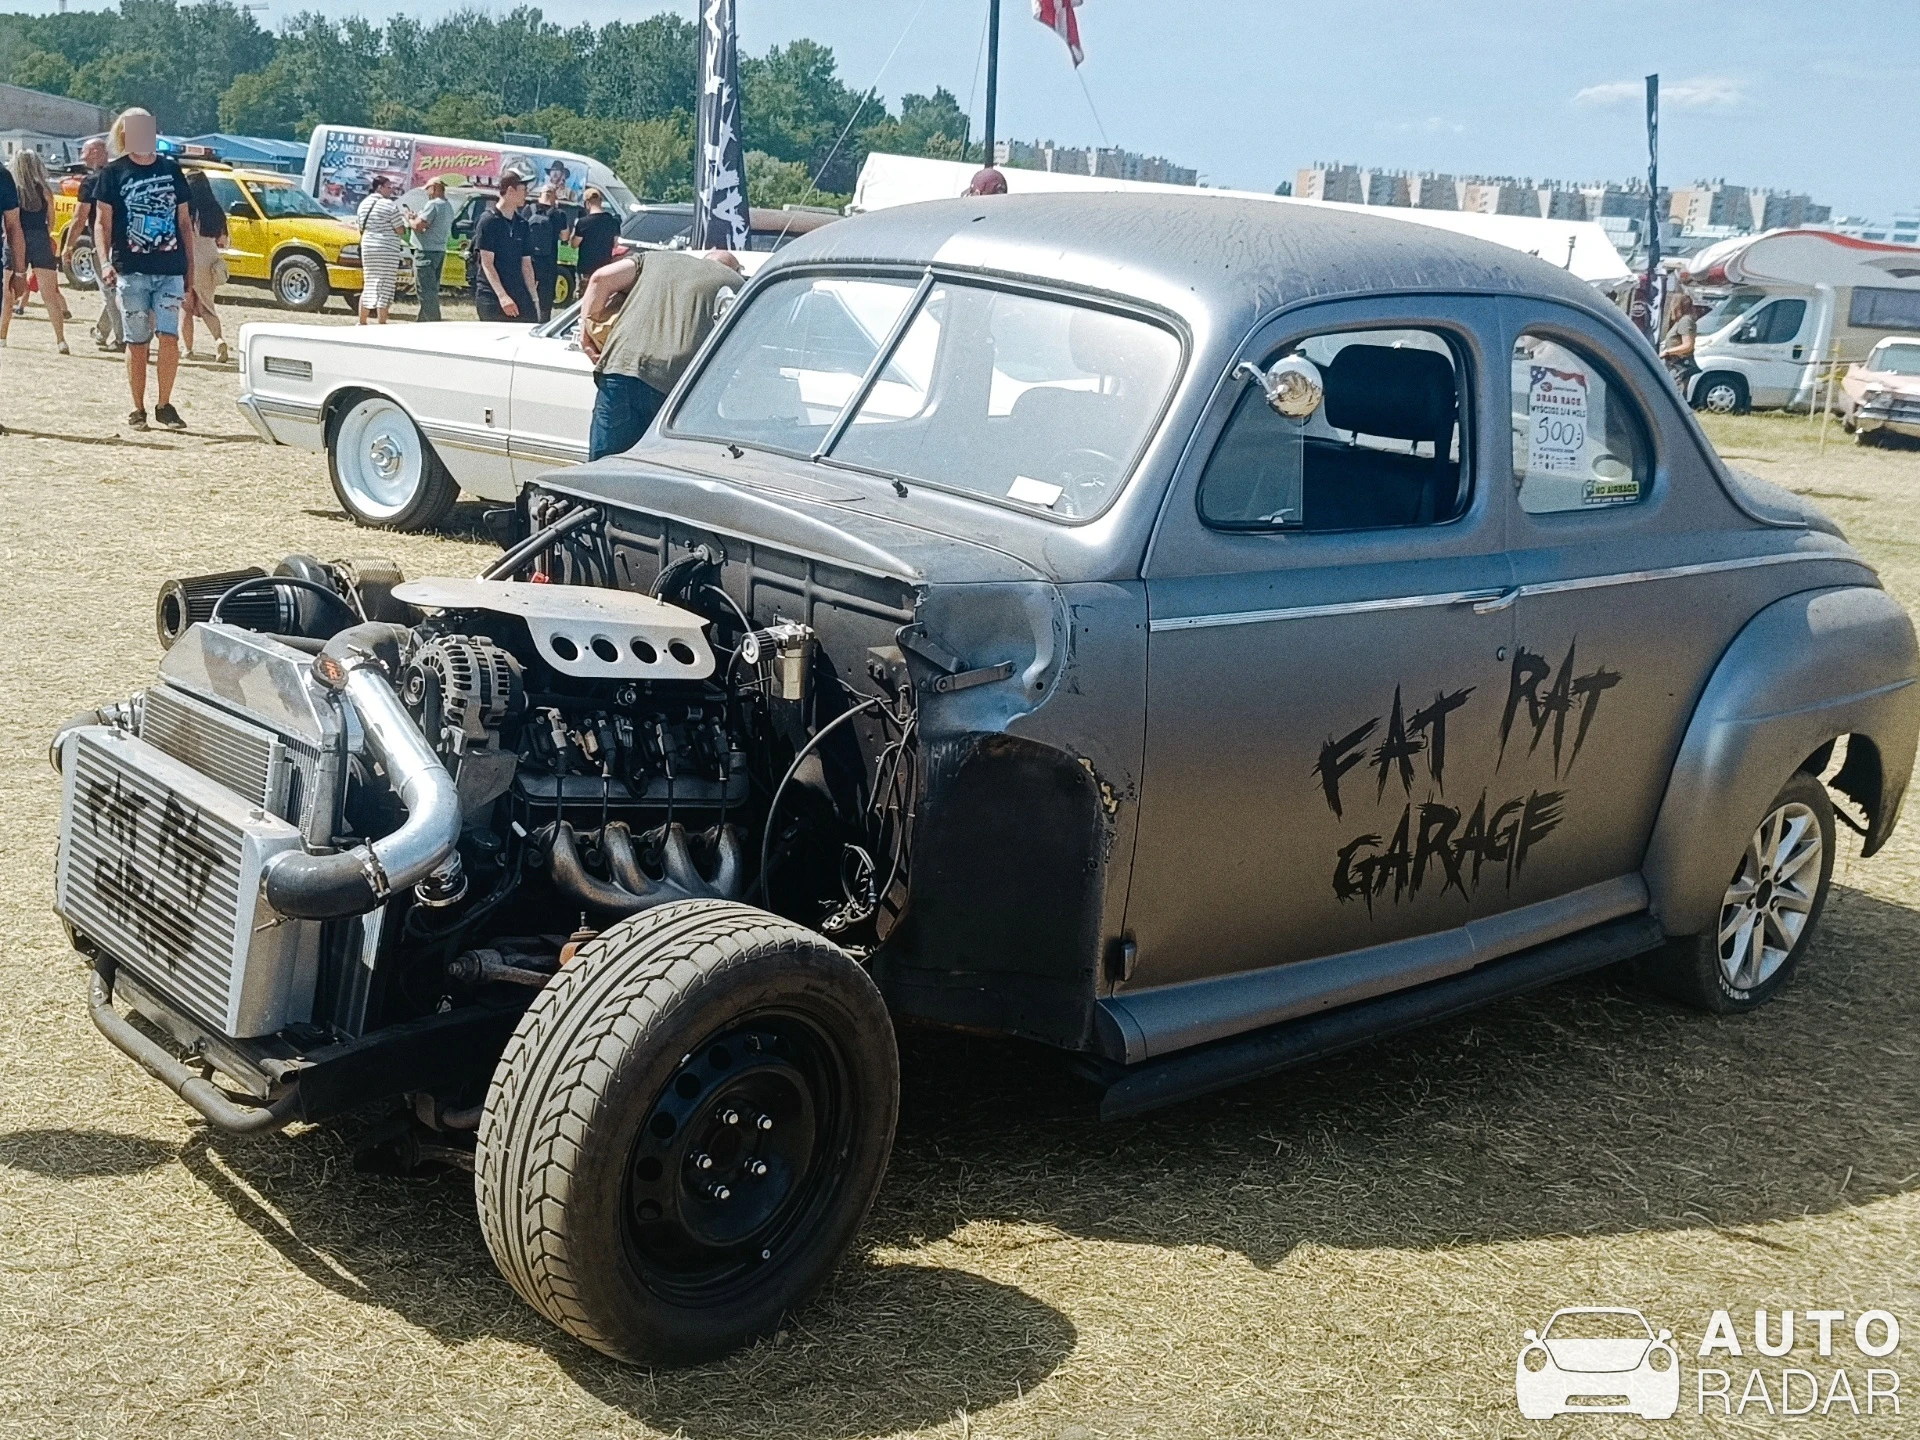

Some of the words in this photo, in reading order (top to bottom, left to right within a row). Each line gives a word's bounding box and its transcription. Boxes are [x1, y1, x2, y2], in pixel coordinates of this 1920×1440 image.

[328, 132, 411, 149] SAMOCHODY
[417, 152, 494, 171] BAYWATCH
[1536, 393, 1558, 404] DRAG
[1561, 396, 1581, 406] RACE
[1595, 486, 1605, 495] NO
[1310, 681, 1477, 823] FAT
[1495, 633, 1623, 781] RAT
[87, 770, 150, 854] FAT
[1332, 786, 1570, 921] GARAGE
